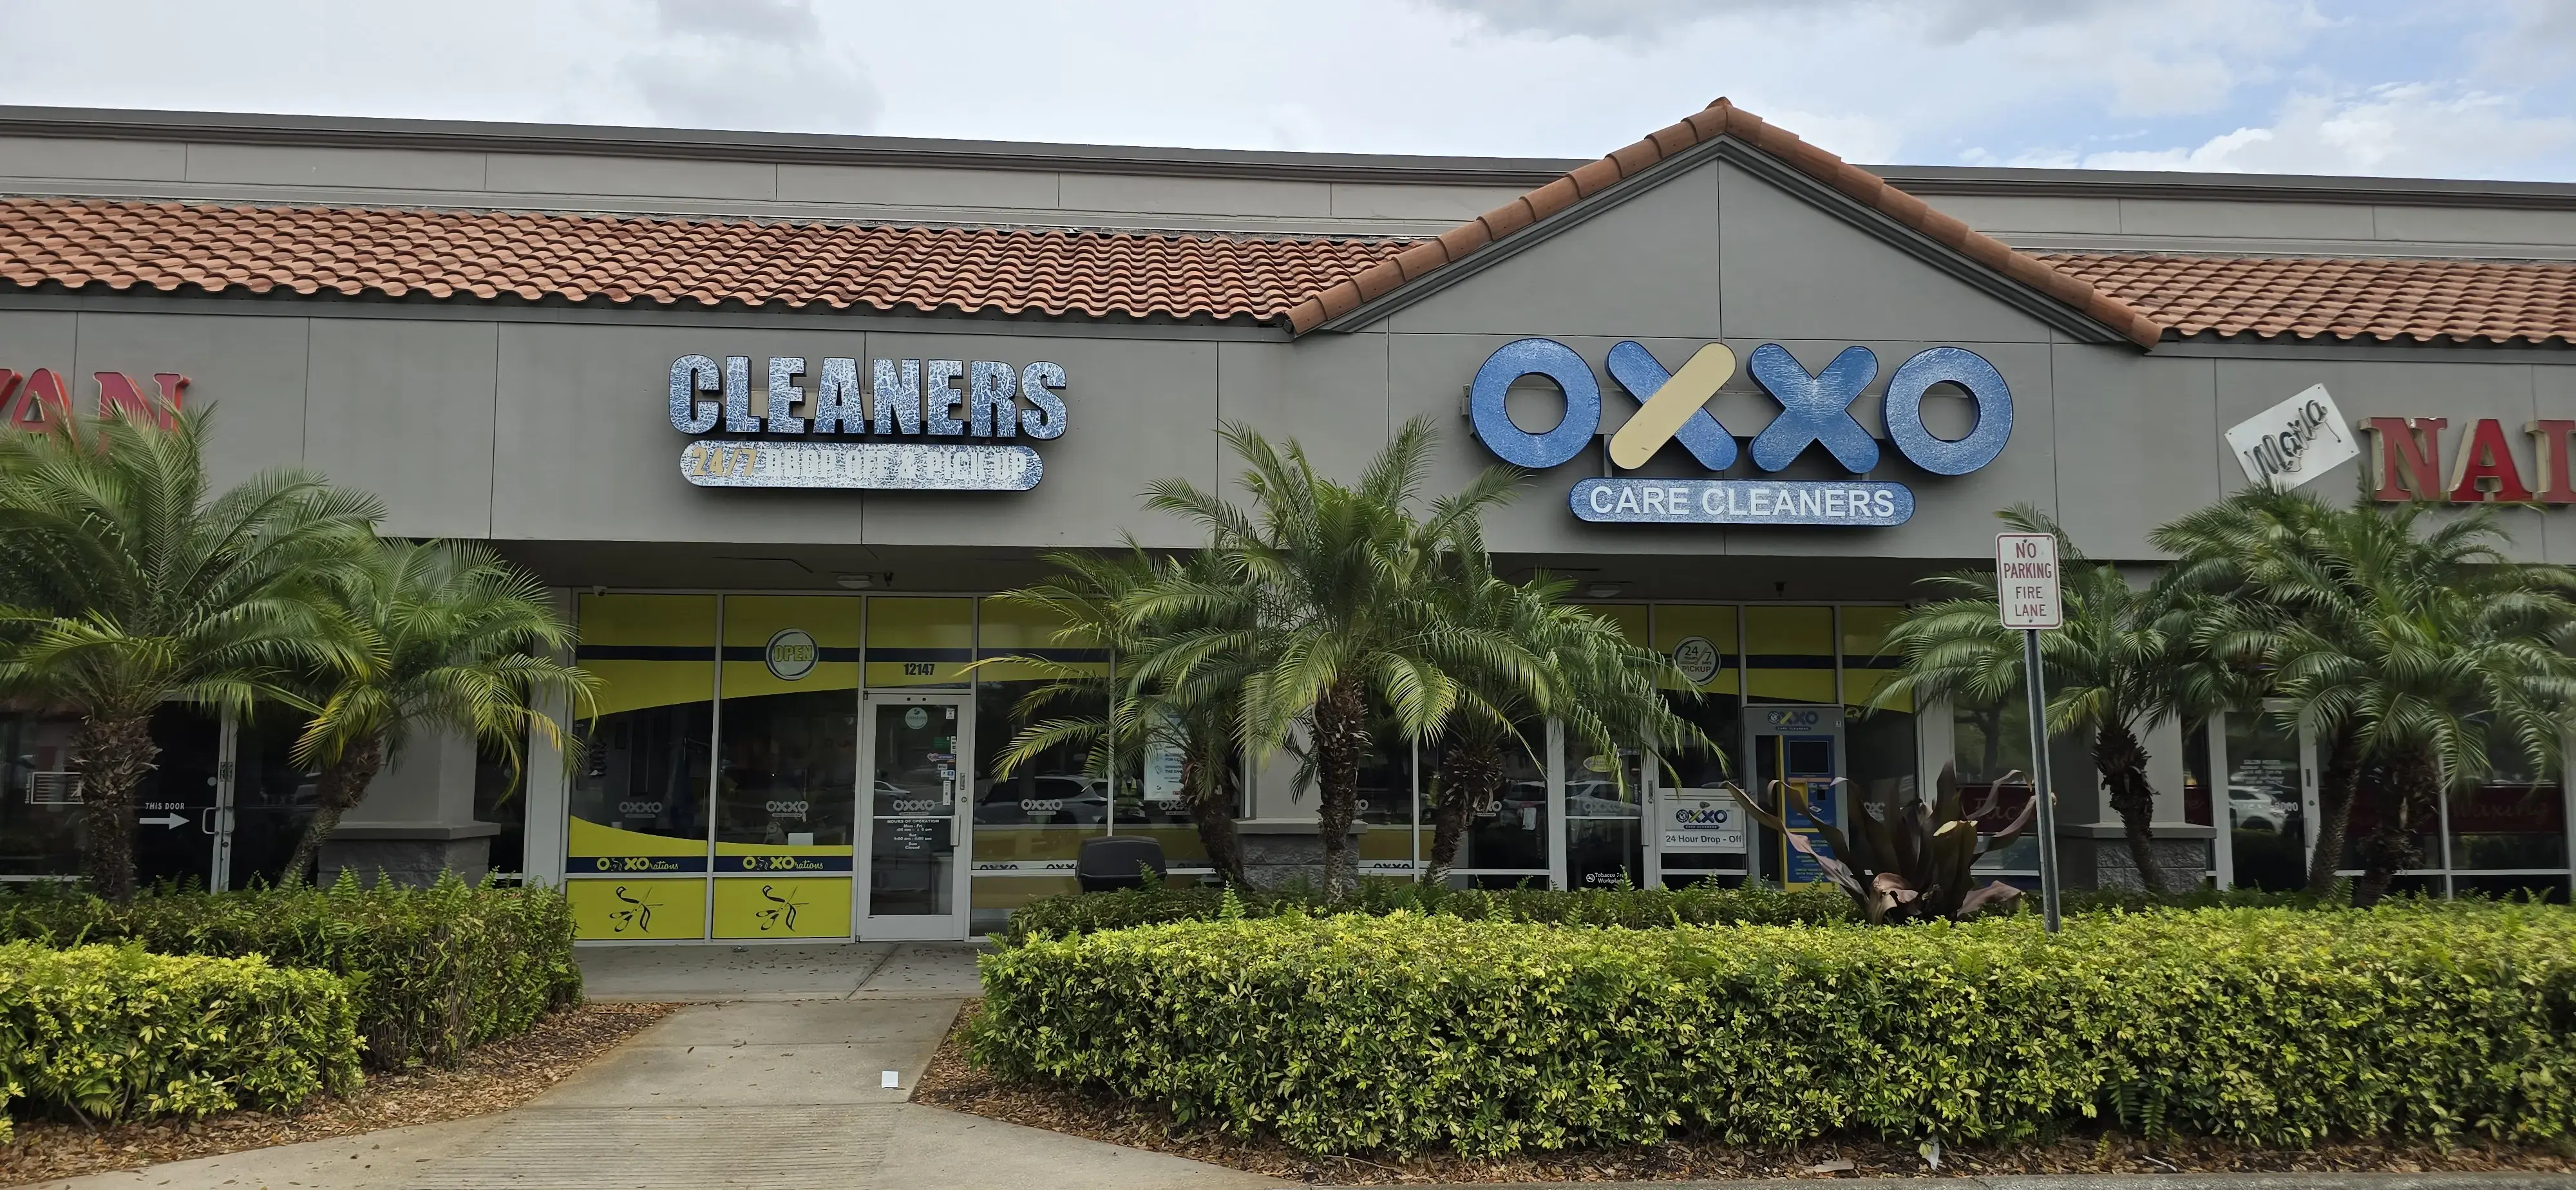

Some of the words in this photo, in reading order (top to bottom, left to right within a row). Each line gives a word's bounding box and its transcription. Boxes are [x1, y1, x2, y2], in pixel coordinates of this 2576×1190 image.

[668, 354, 1069, 441] CLEANERS
[0, 368, 192, 454] AN
[1470, 338, 2014, 475] OXXO
[691, 448, 757, 477] 24/7
[766, 450, 837, 480] DROP
[845, 451, 891, 480] OFF
[898, 451, 918, 480] &
[927, 451, 986, 481] PICK
[993, 451, 1028, 482] UP
[1589, 486, 1690, 515] CARE
[1702, 487, 1896, 518] CLEANERS
[2016, 542, 2037, 558] NO
[2003, 563, 2052, 579] PARKING
[2015, 586, 2043, 600] FIRE
[2014, 604, 2047, 617] LANE
[773, 645, 813, 662] OPEN
[904, 663, 935, 675] 12147
[1768, 710, 1819, 725] OXXO
[619, 801, 663, 813] OXXO
[766, 800, 809, 812] OXXO
[893, 799, 936, 811] OXXO
[1021, 798, 1063, 811] OXXO
[1676, 809, 1728, 824] OXXO
[1701, 835, 1721, 844] Drop
